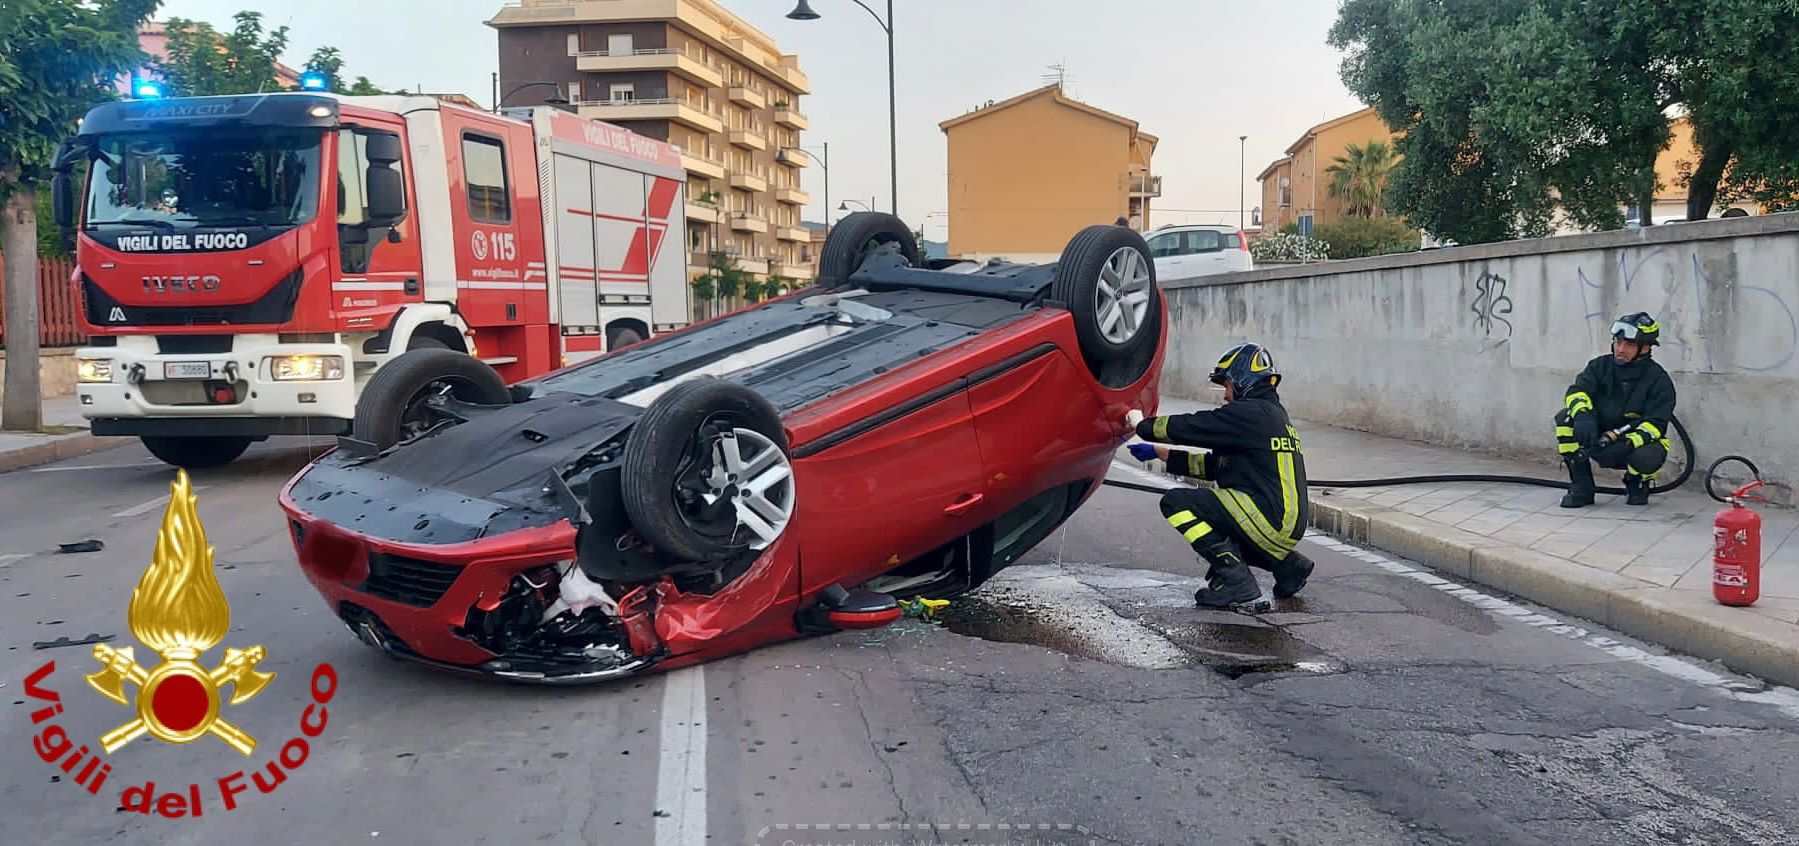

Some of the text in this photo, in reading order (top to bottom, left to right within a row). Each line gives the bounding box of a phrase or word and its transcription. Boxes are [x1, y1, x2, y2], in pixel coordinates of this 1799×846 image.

[195, 103, 233, 115] CITY
[611, 131, 630, 153] DEL
[117, 232, 247, 251] VIGILI DEL FUOCO
[491, 231, 516, 261] 115
[142, 275, 221, 292] IVECO
[1270, 437, 1295, 451] DEL
